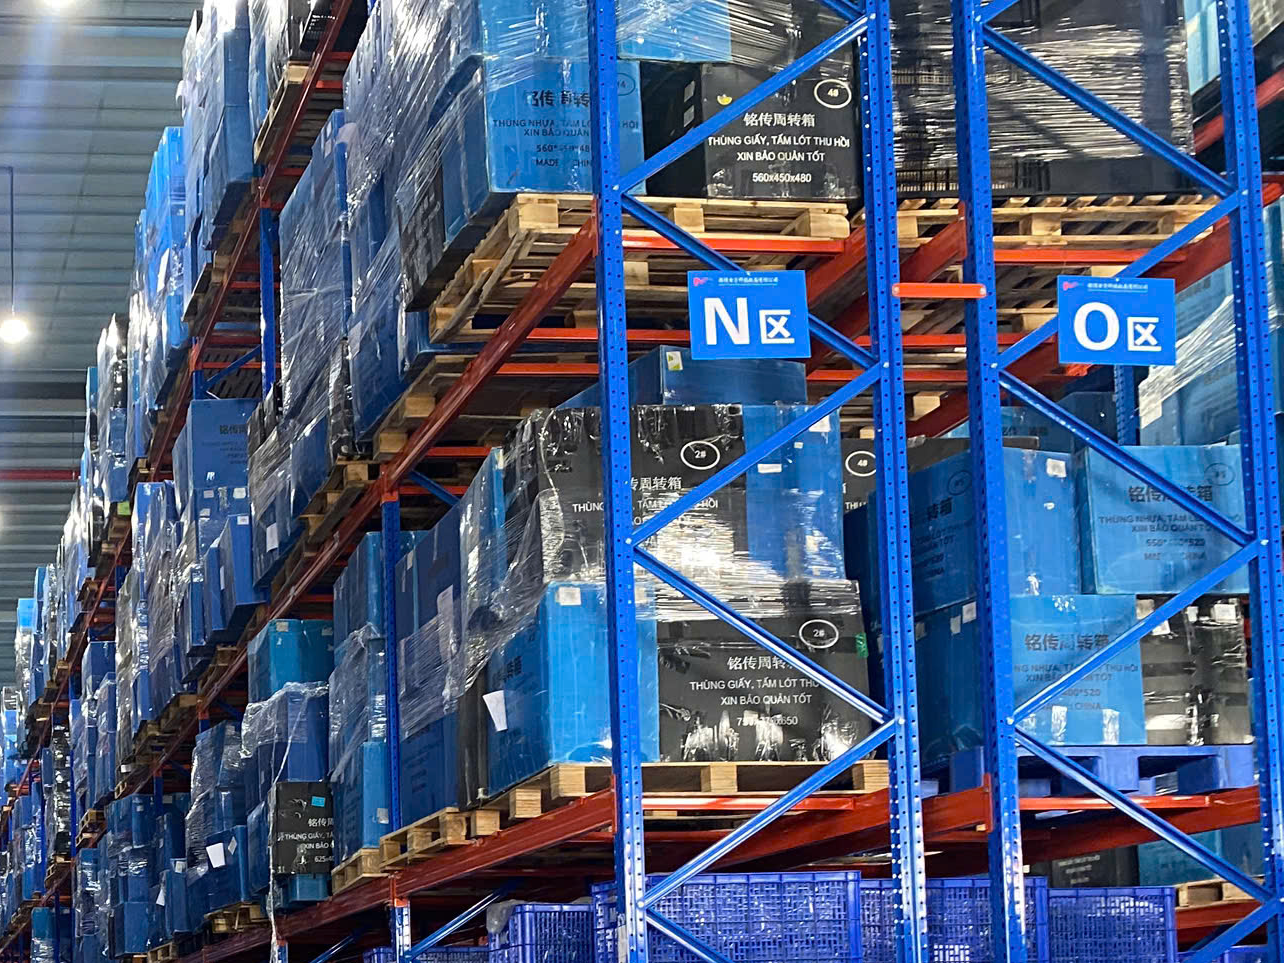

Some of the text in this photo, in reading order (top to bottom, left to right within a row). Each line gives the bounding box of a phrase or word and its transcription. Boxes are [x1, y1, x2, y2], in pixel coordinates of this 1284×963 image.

[743, 112, 816, 127] 铭传周转箱
[813, 136, 832, 146] THU
[736, 151, 754, 162] XIN
[752, 172, 812, 183] 560x450x480
[727, 655, 793, 671] 铭传周转
[720, 695, 738, 706] XIN
